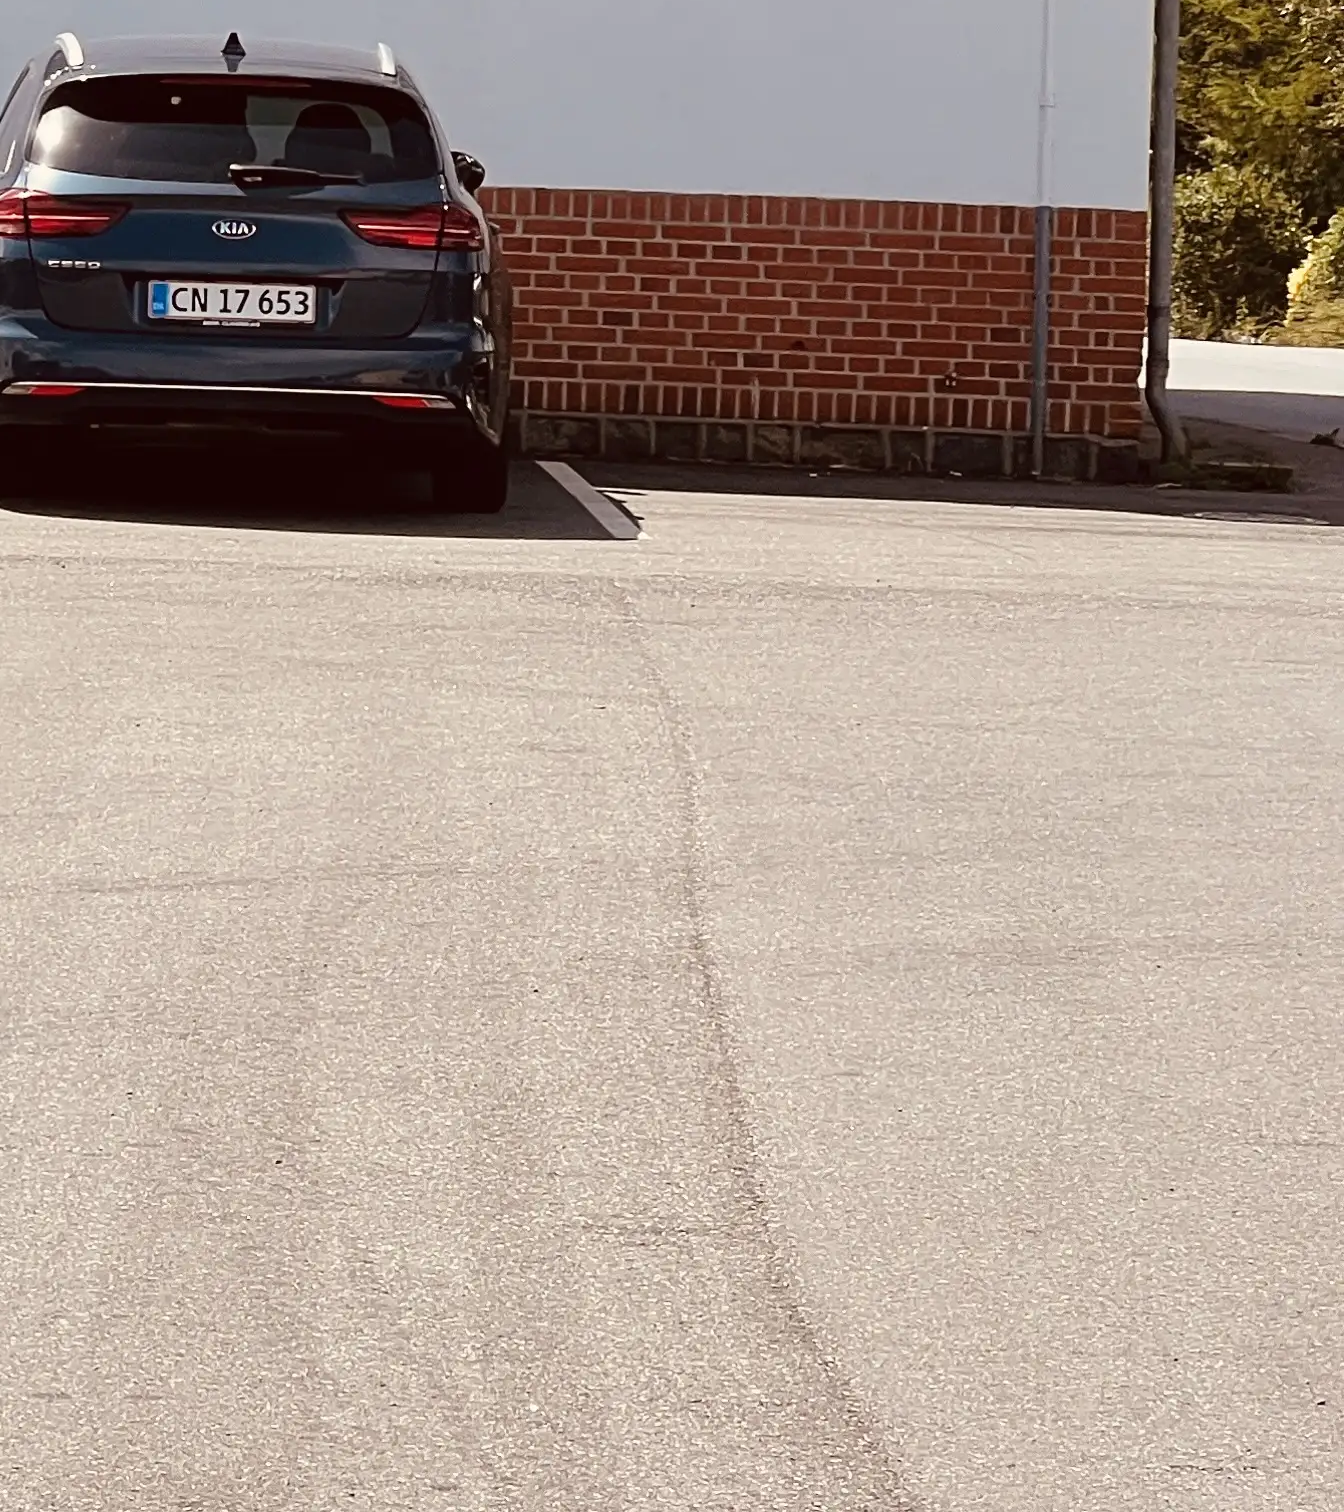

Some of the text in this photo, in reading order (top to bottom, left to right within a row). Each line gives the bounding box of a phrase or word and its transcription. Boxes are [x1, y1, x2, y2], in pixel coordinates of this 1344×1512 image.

[220, 221, 249, 235] KIA
[171, 288, 208, 313] CN
[219, 288, 250, 314] 17
[258, 290, 310, 316] 653
